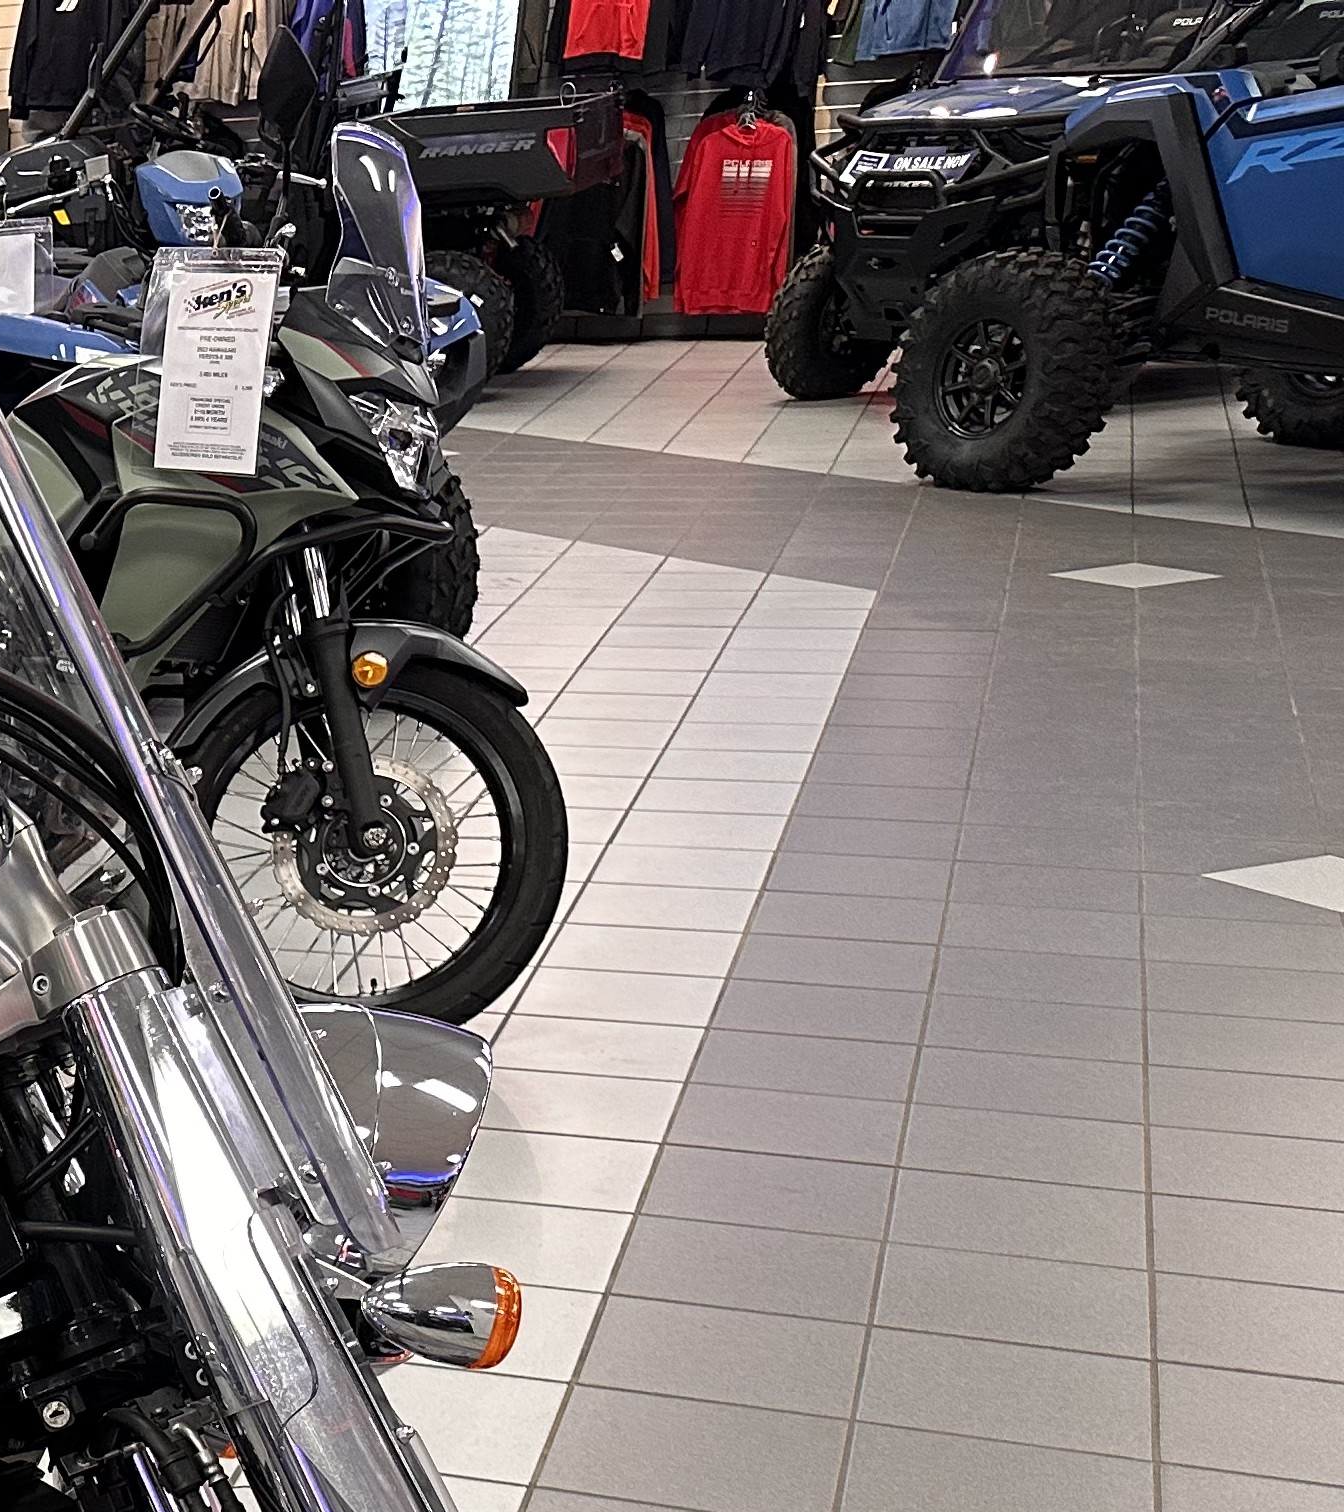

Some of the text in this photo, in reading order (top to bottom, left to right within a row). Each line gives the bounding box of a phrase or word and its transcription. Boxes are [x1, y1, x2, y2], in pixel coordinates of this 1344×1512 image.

[418, 139, 536, 159] RANGER
[893, 156, 912, 170] ON
[912, 156, 945, 170] SALE
[943, 153, 972, 170] NOW
[1205, 306, 1290, 334] POLARIS
